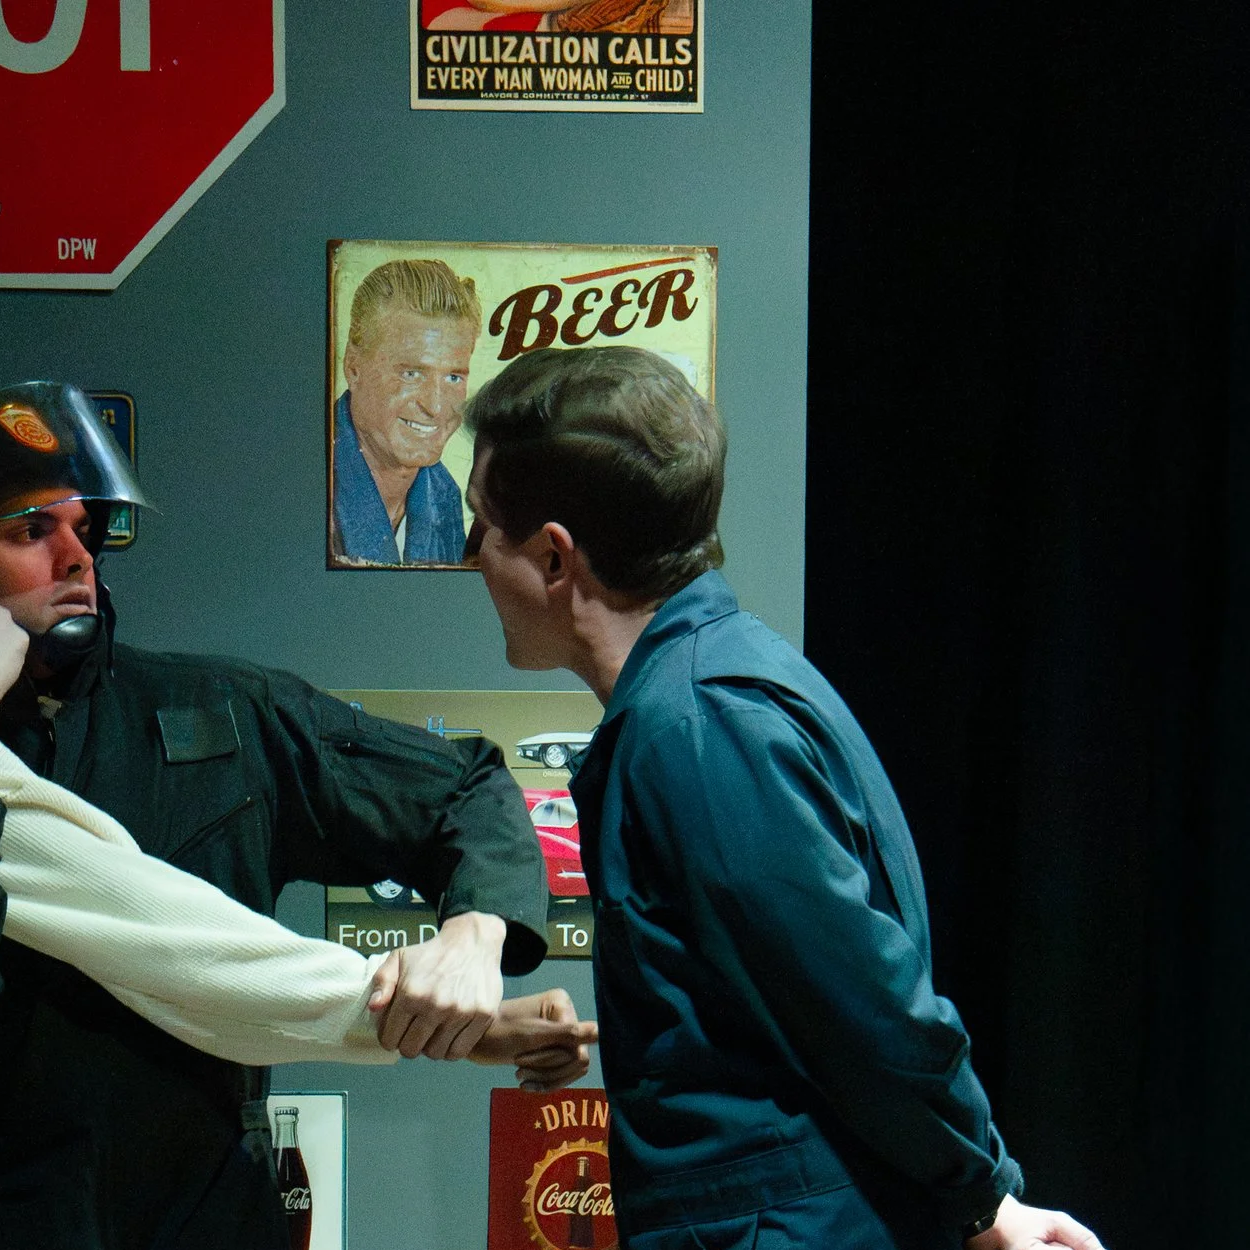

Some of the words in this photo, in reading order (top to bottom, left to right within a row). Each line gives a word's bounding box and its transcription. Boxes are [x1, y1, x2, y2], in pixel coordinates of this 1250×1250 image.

[425, 35, 600, 65] CIVILIZATION
[608, 38, 693, 65] CALLS
[426, 66, 488, 91] EVERY
[494, 67, 533, 91] MAN
[539, 68, 608, 92] WOMAN
[611, 73, 633, 87] AND
[57, 238, 97, 261] DPW
[488, 268, 699, 361] BEER
[338, 924, 407, 947] From
[556, 923, 589, 947] To
